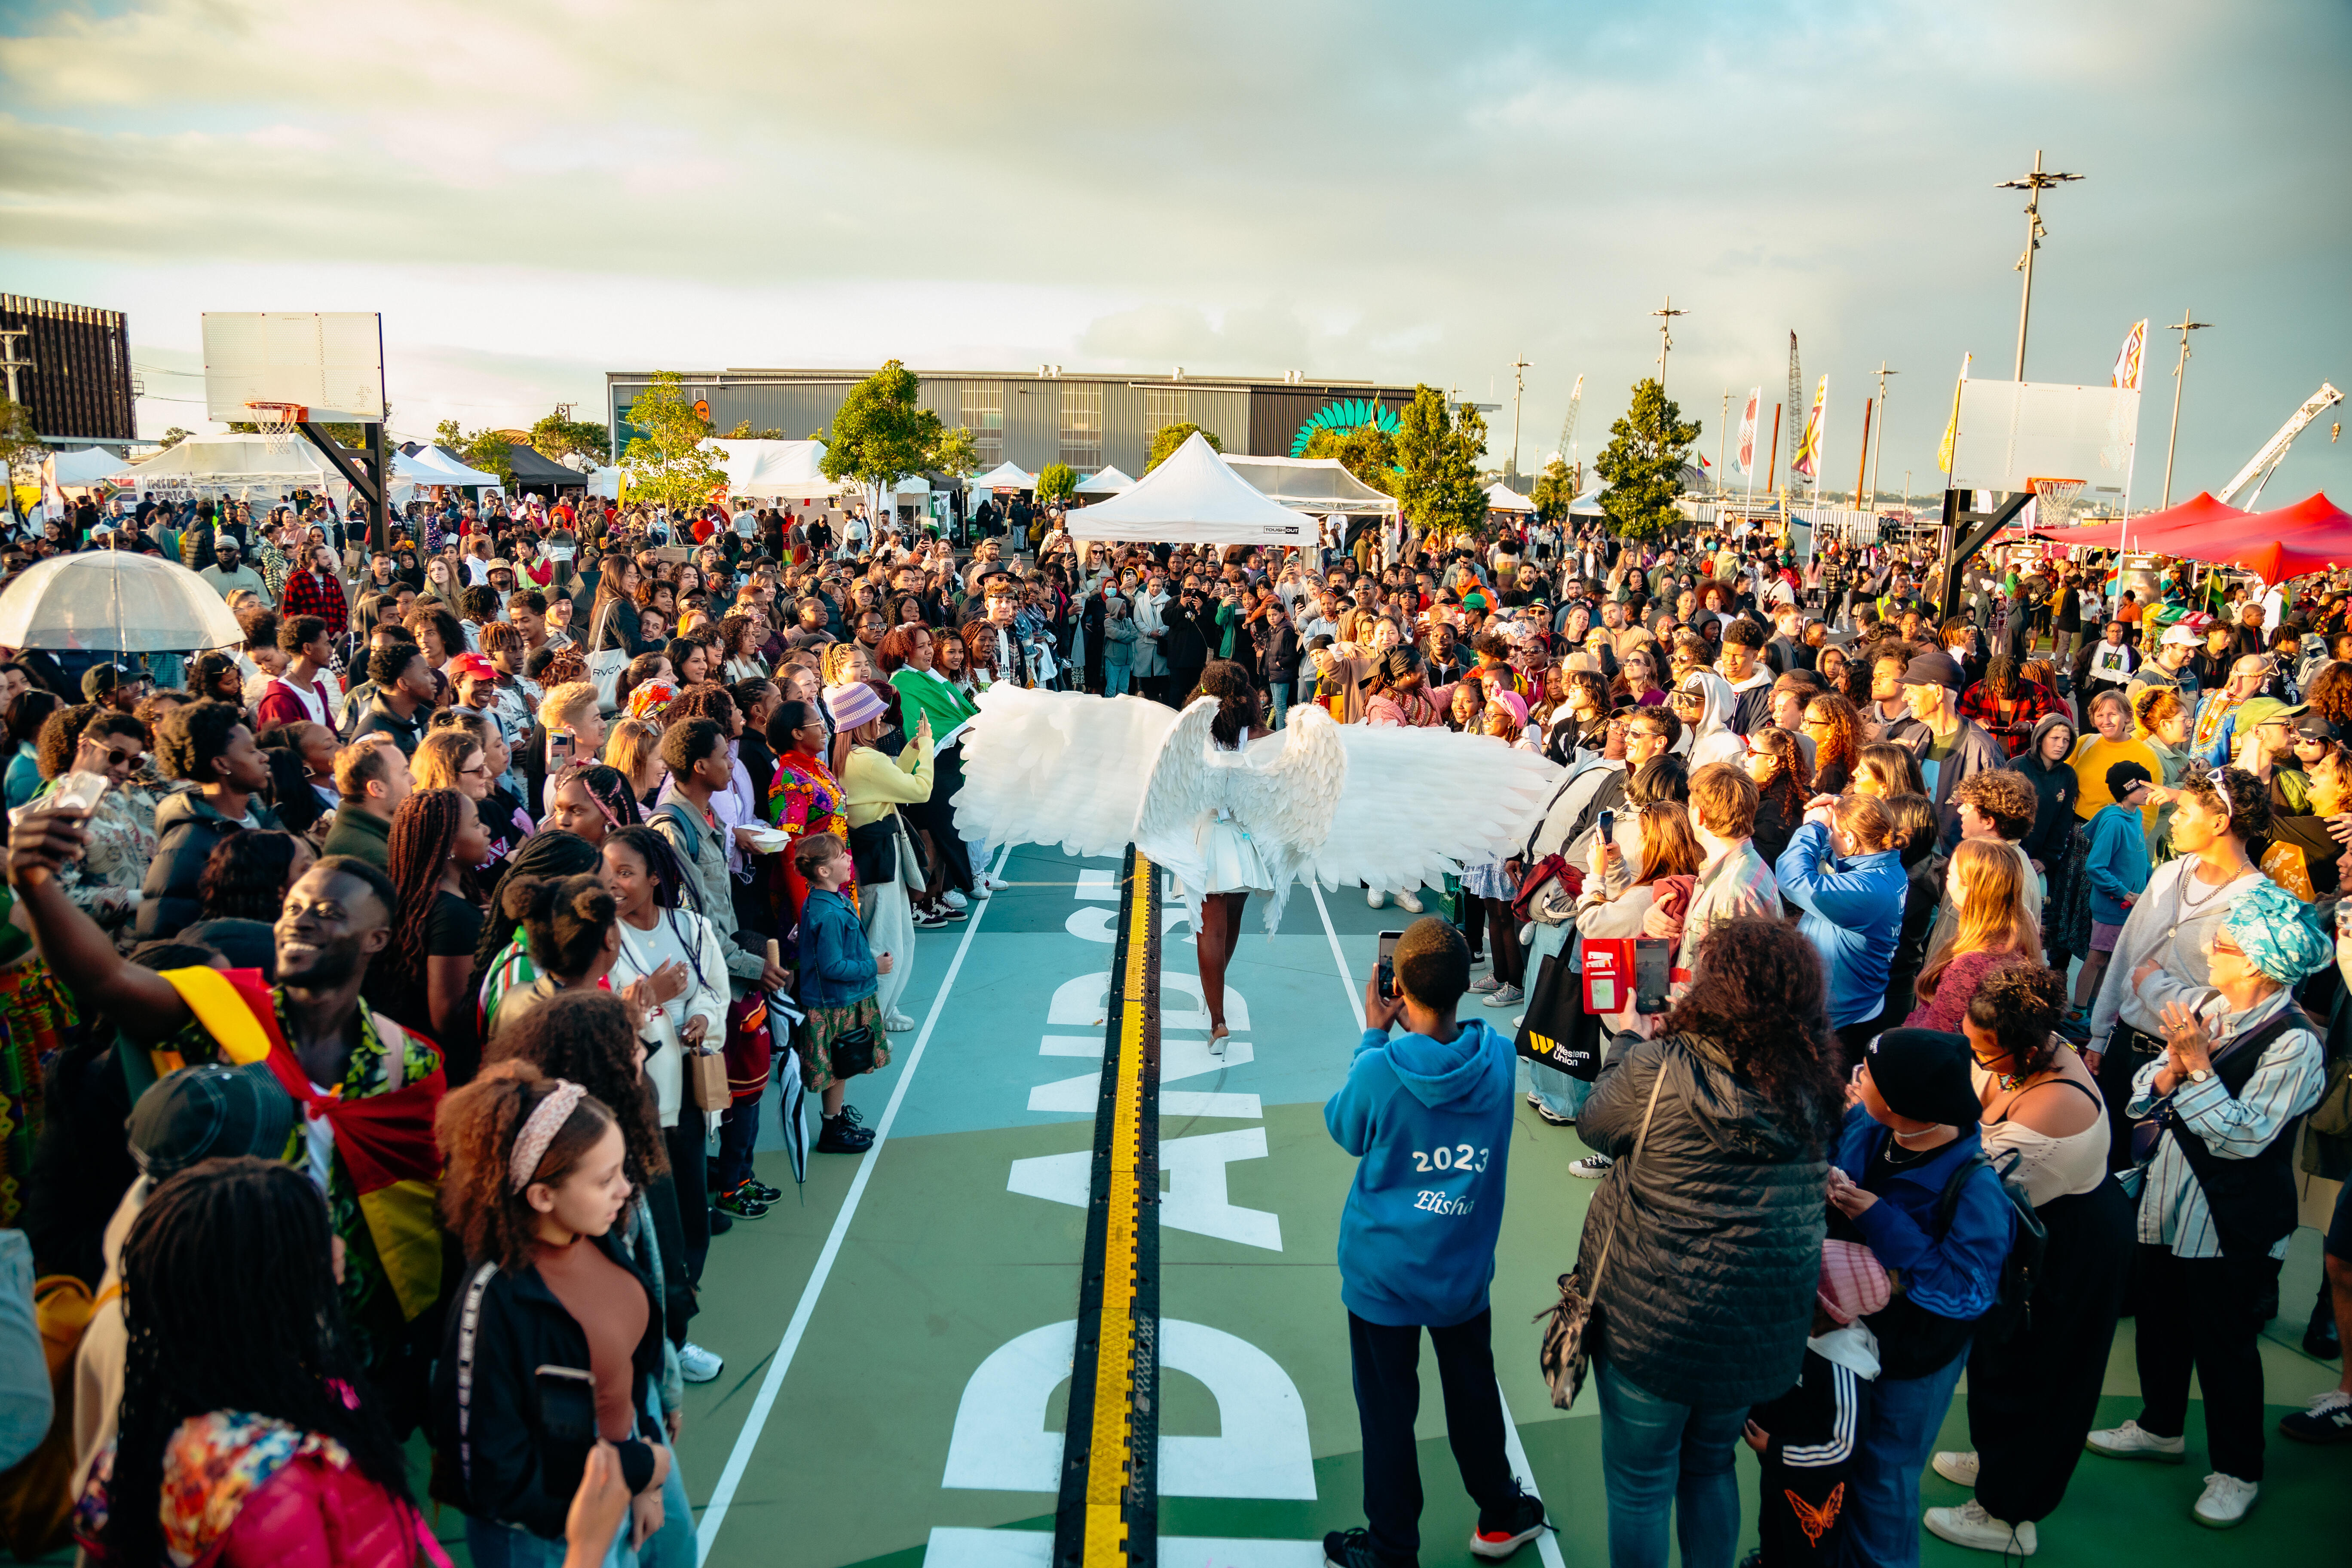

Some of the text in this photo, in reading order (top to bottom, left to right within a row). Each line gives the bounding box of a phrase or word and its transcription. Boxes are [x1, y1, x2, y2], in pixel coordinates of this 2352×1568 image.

[147, 478, 187, 489] INSIDE
[153, 490, 196, 501] FRICA
[593, 665, 622, 677] RVCA
[1553, 1050, 1578, 1066] Union
[1556, 1041, 1589, 1060] Western
[1007, 971, 1283, 1253] AND
[1412, 1143, 1489, 1173] 2023
[1413, 1190, 1475, 1216] Elisha
